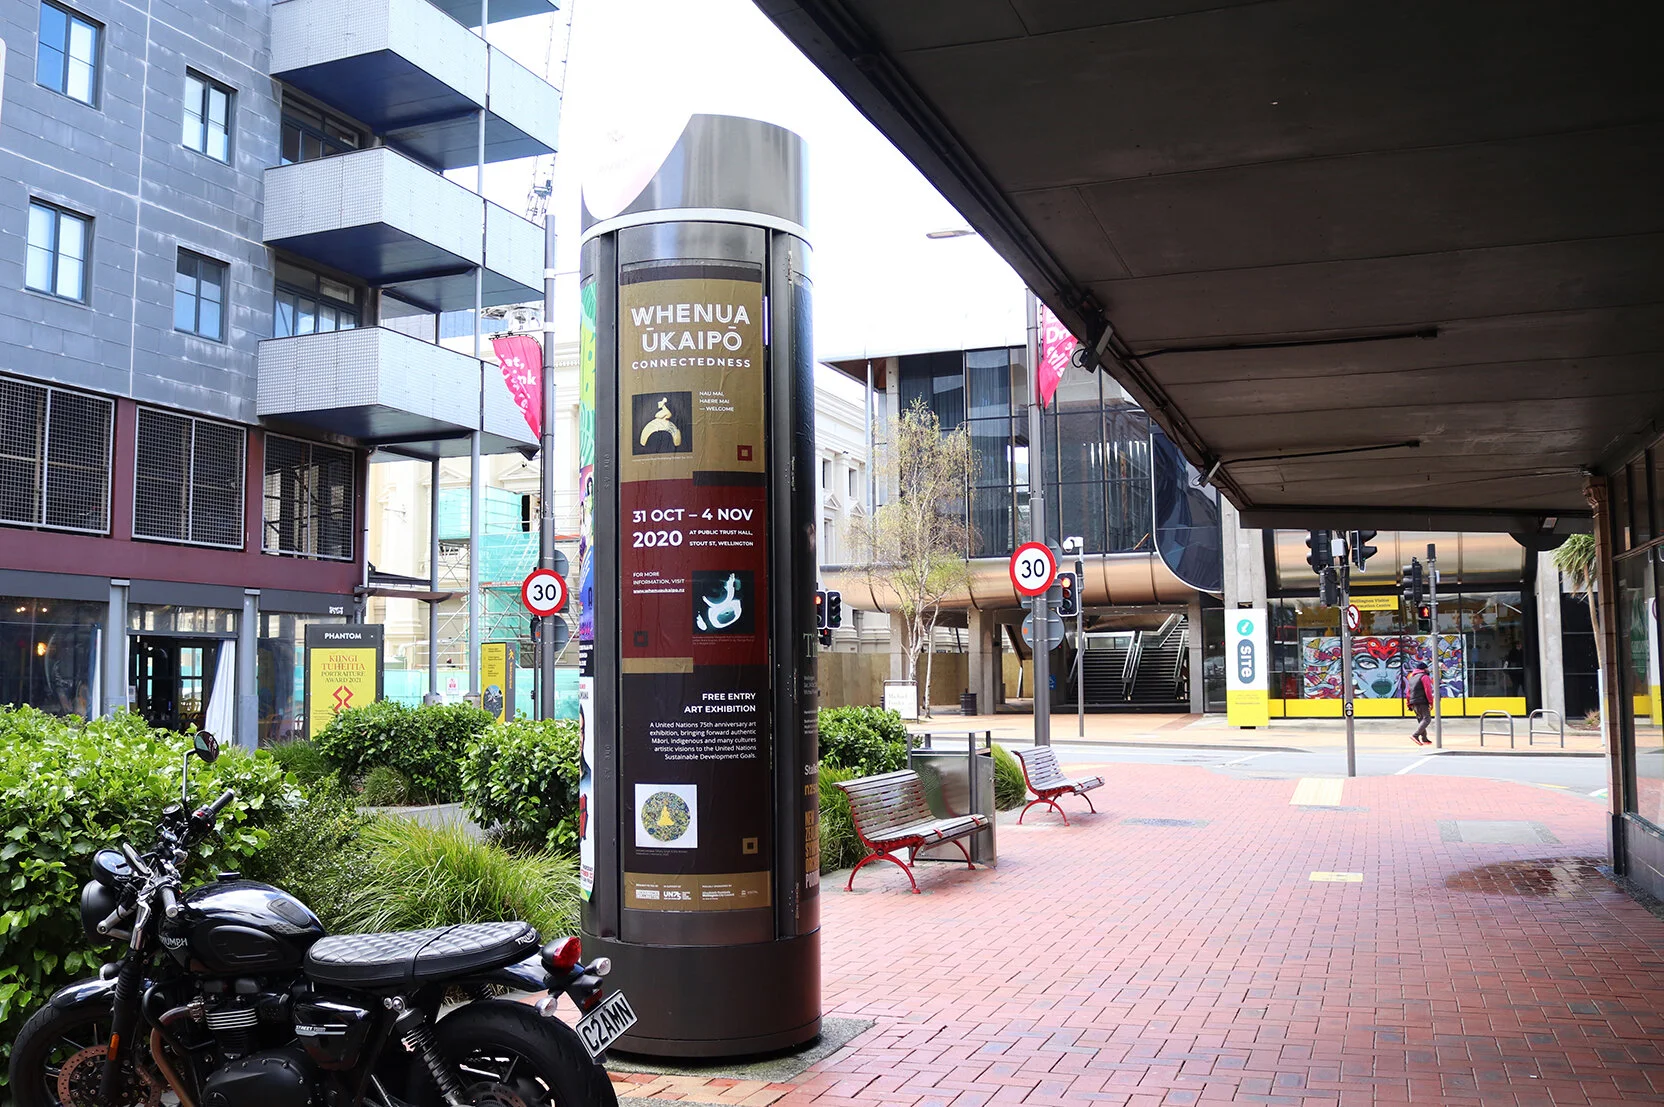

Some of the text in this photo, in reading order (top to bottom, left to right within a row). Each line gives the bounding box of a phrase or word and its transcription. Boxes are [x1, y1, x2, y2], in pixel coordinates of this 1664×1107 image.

[631, 303, 750, 326] WHENUA
[642, 326, 742, 352] ŪKAIPŌ
[632, 357, 751, 370] CONNECTEDNESS
[632, 510, 646, 523] 31
[650, 508, 685, 522] OCT
[701, 508, 713, 521] 4
[718, 508, 754, 521] NOV
[632, 530, 683, 548] 2020
[1021, 558, 1045, 579] 30
[533, 584, 557, 601] 30
[324, 632, 362, 640] PHANTOM
[321, 663, 366, 671] TUHEITIA
[702, 692, 757, 701] FREE ENTRY
[684, 704, 756, 714] ART EXHIBITION
[714, 721, 748, 730] anniversary
[680, 730, 706, 738] bringing
[717, 738, 734, 746] many
[699, 753, 739, 761] Development
[582, 996, 634, 1052] C2AMN
